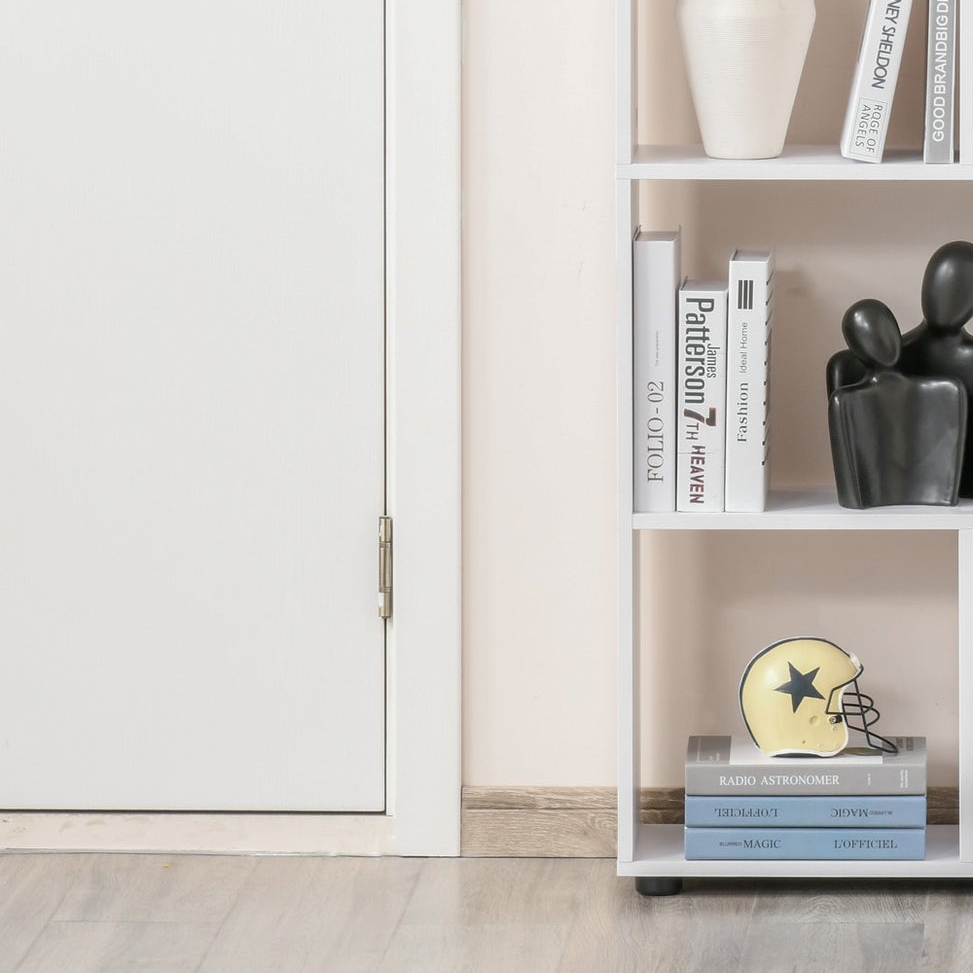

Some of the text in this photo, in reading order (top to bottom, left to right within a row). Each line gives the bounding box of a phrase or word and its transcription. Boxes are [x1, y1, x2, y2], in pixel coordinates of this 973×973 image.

[871, 26, 896, 90] SHELDON
[855, 104, 871, 148] ANGELS
[932, 96, 946, 142] GOOD
[865, 137, 875, 153] OF
[684, 298, 715, 404] Patterson
[706, 343, 720, 378] James
[740, 321, 748, 374] Ideal Home
[647, 381, 664, 402] 02
[737, 382, 749, 442] Fashion
[647, 418, 664, 483] FOLIO
[689, 446, 706, 504] HEAVEN
[719, 775, 840, 786] RADIO ASTRONOMER
[714, 808, 778, 817] L'OFFICIEL
[830, 808, 869, 818] MAGIC
[743, 839, 782, 849] MAGIC
[834, 839, 898, 849] L'OFFICIEL
